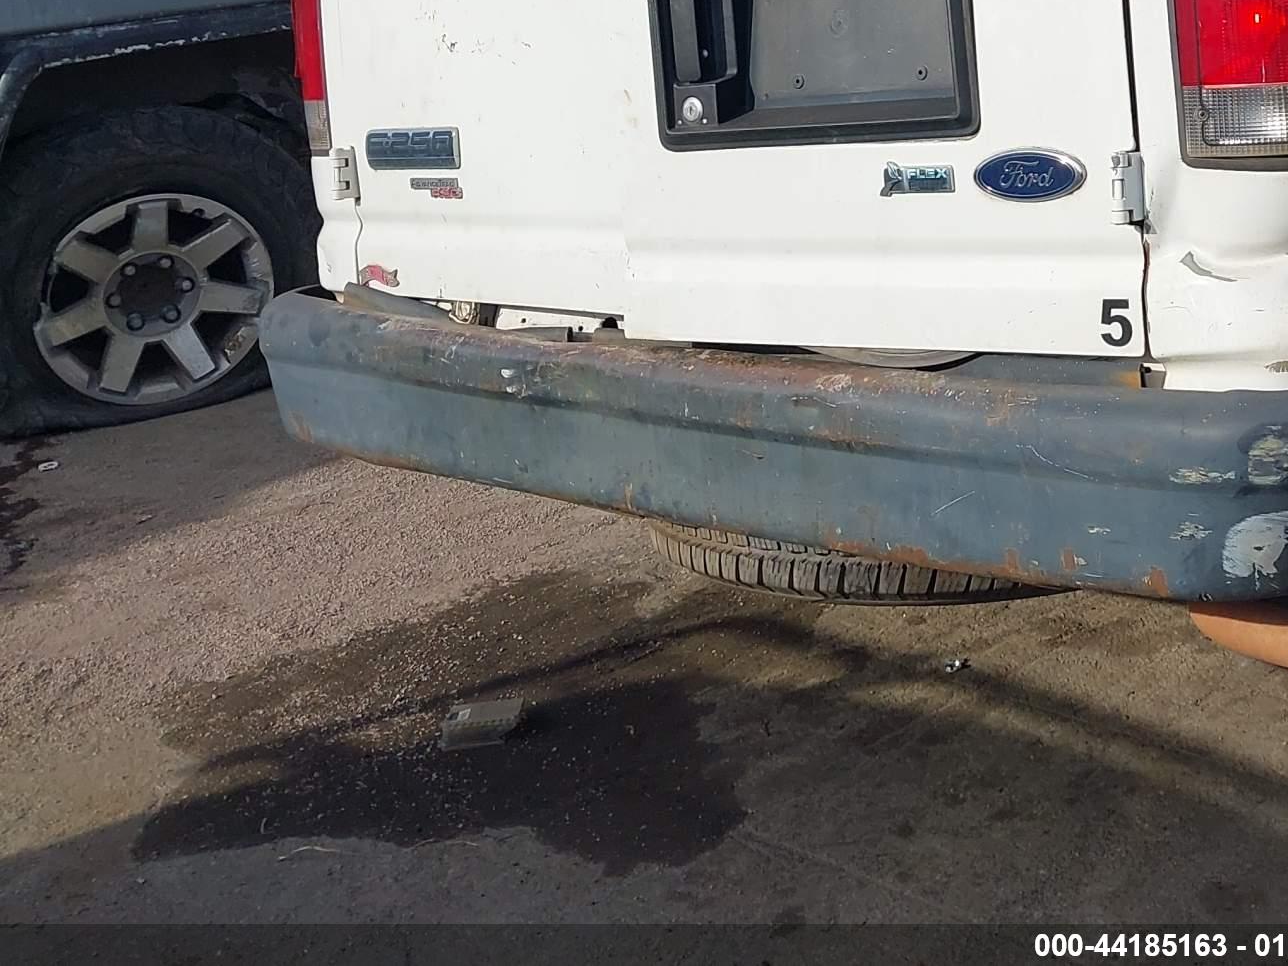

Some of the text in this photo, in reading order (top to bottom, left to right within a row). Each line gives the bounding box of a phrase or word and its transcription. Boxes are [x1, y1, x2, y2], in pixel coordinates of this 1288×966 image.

[907, 168, 948, 179] FLEX
[999, 160, 1055, 189] Ford
[1100, 298, 1133, 347] 5
